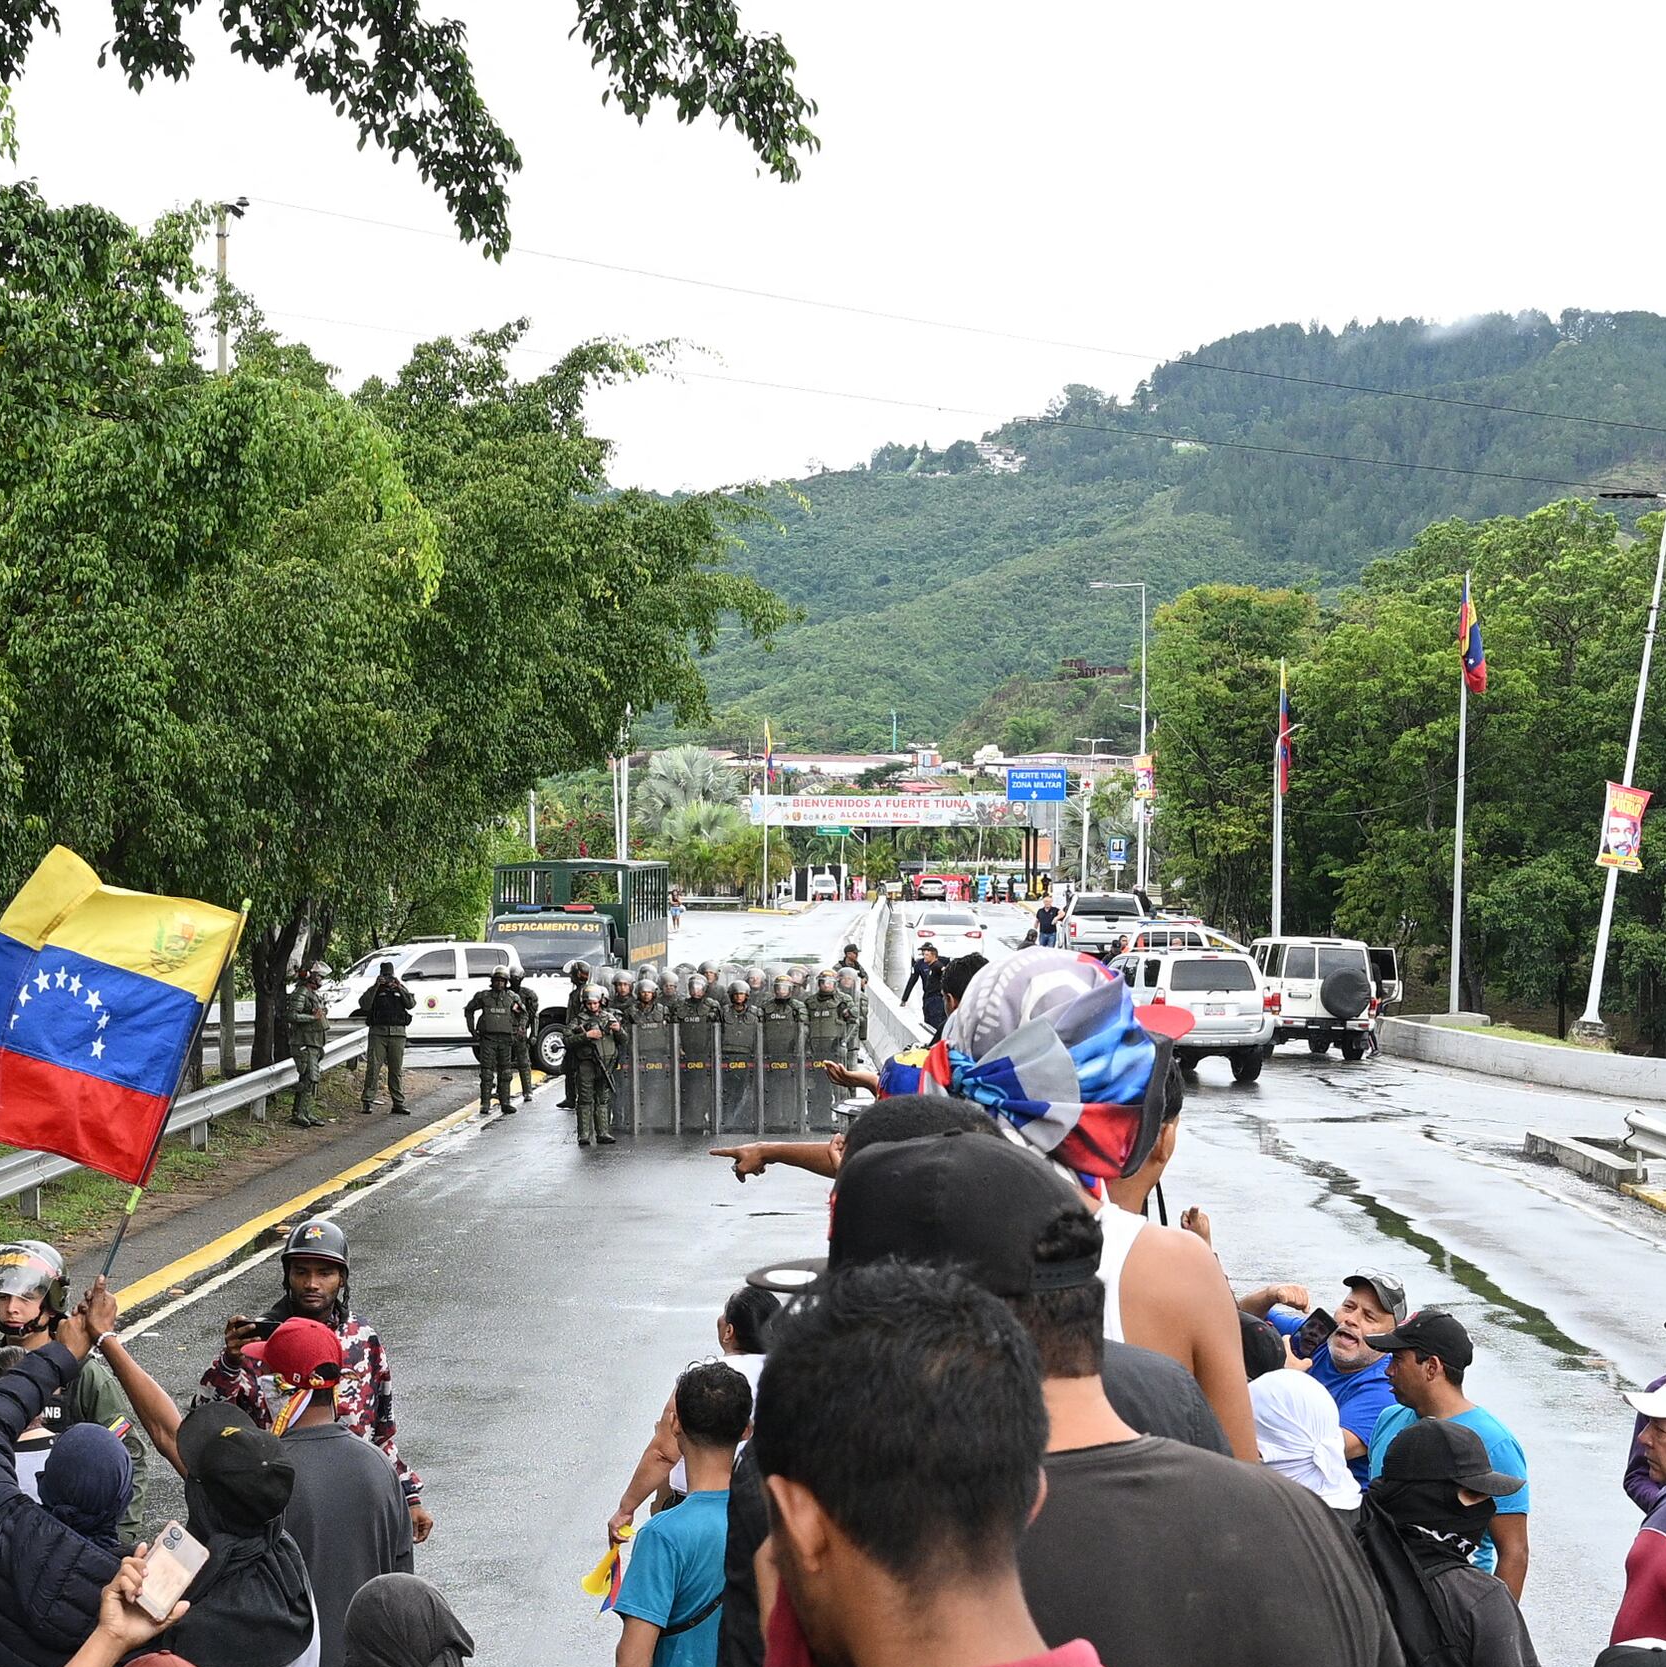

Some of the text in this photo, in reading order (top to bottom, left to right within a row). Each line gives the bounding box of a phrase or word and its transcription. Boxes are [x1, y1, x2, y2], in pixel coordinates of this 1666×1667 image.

[1011, 772, 1062, 780] FUERTE TIUNA
[1011, 781, 1062, 789] ZONA MILITAR
[792, 798, 970, 809] BIENVENIDOS A FUERTE TIUNA
[840, 811, 889, 819] ALCABALA
[497, 922, 601, 933] DESTACAMENTO 431
[646, 1062, 663, 1070] GNB
[687, 1061, 704, 1069] GNB
[729, 1061, 746, 1069] GNB
[770, 1062, 787, 1070] GNB
